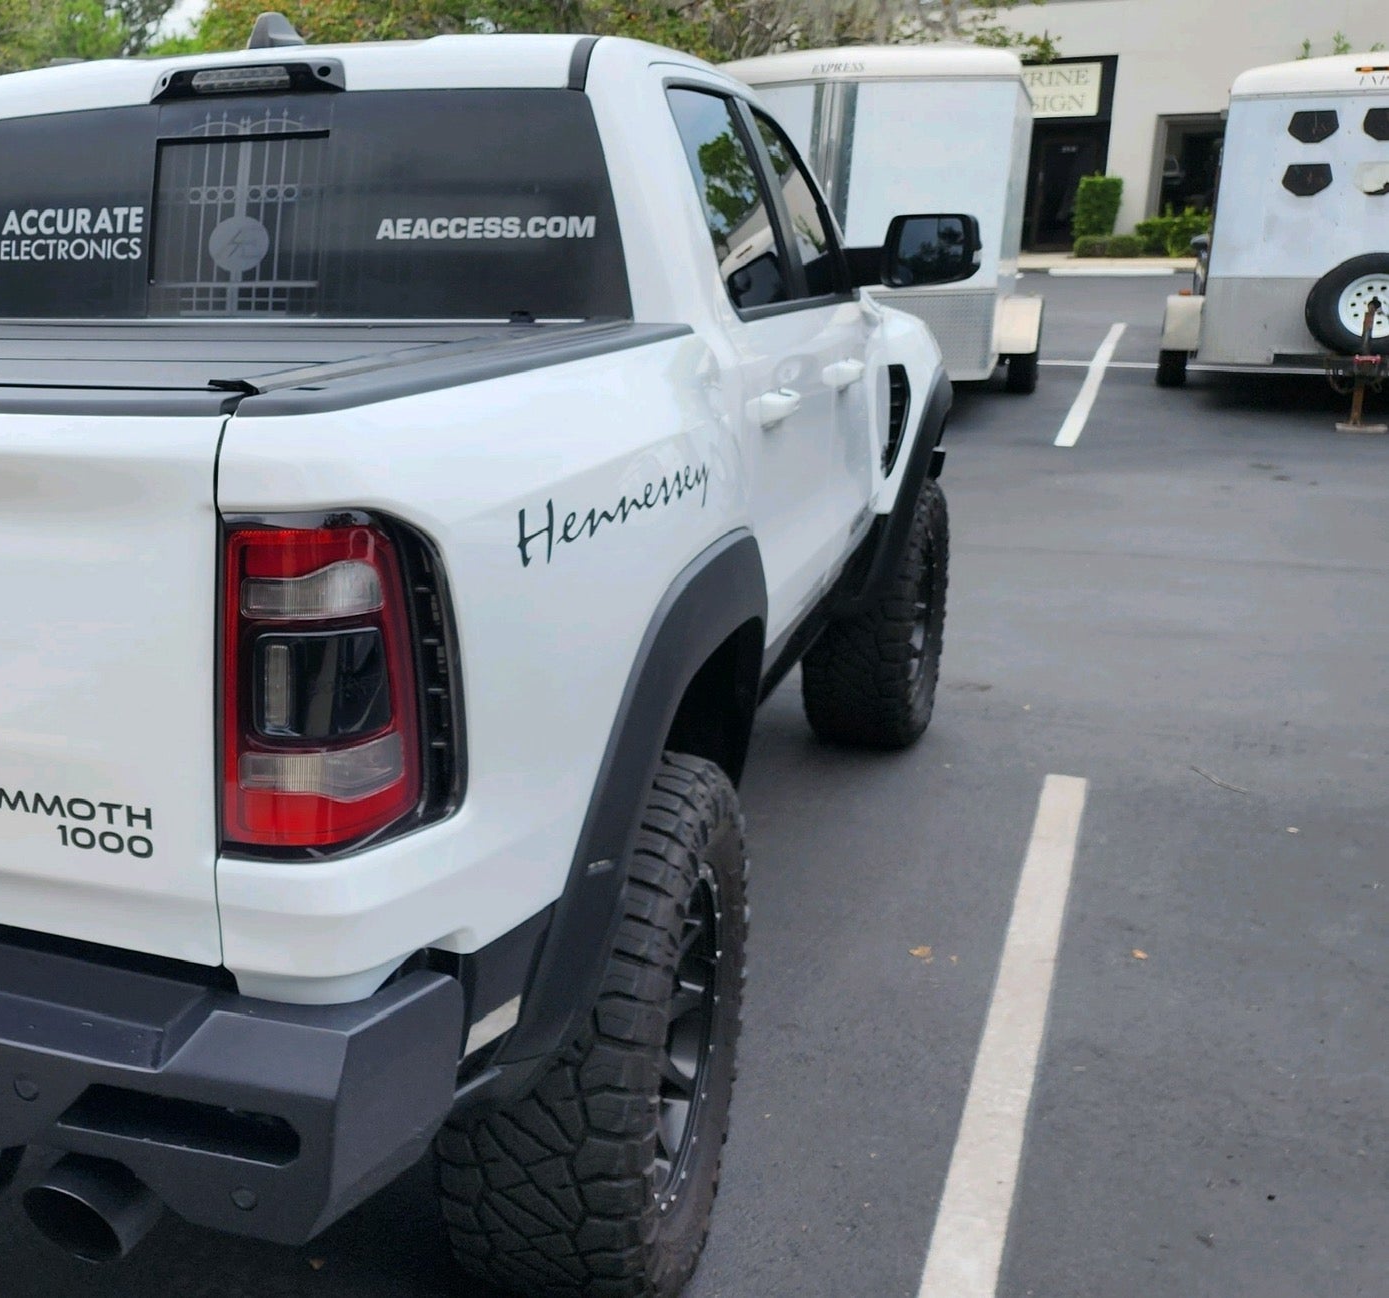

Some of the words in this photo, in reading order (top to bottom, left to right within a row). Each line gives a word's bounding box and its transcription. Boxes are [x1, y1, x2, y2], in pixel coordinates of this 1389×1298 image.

[811, 62, 866, 73] EXPRESS
[1023, 69, 1089, 87] RINE
[1, 206, 144, 236] ACCURATE
[376, 215, 597, 240] AEACCESS.COM
[0, 237, 142, 261] ELECTRONICS
[516, 461, 710, 568] Hennessey
[56, 824, 154, 859] 1000
